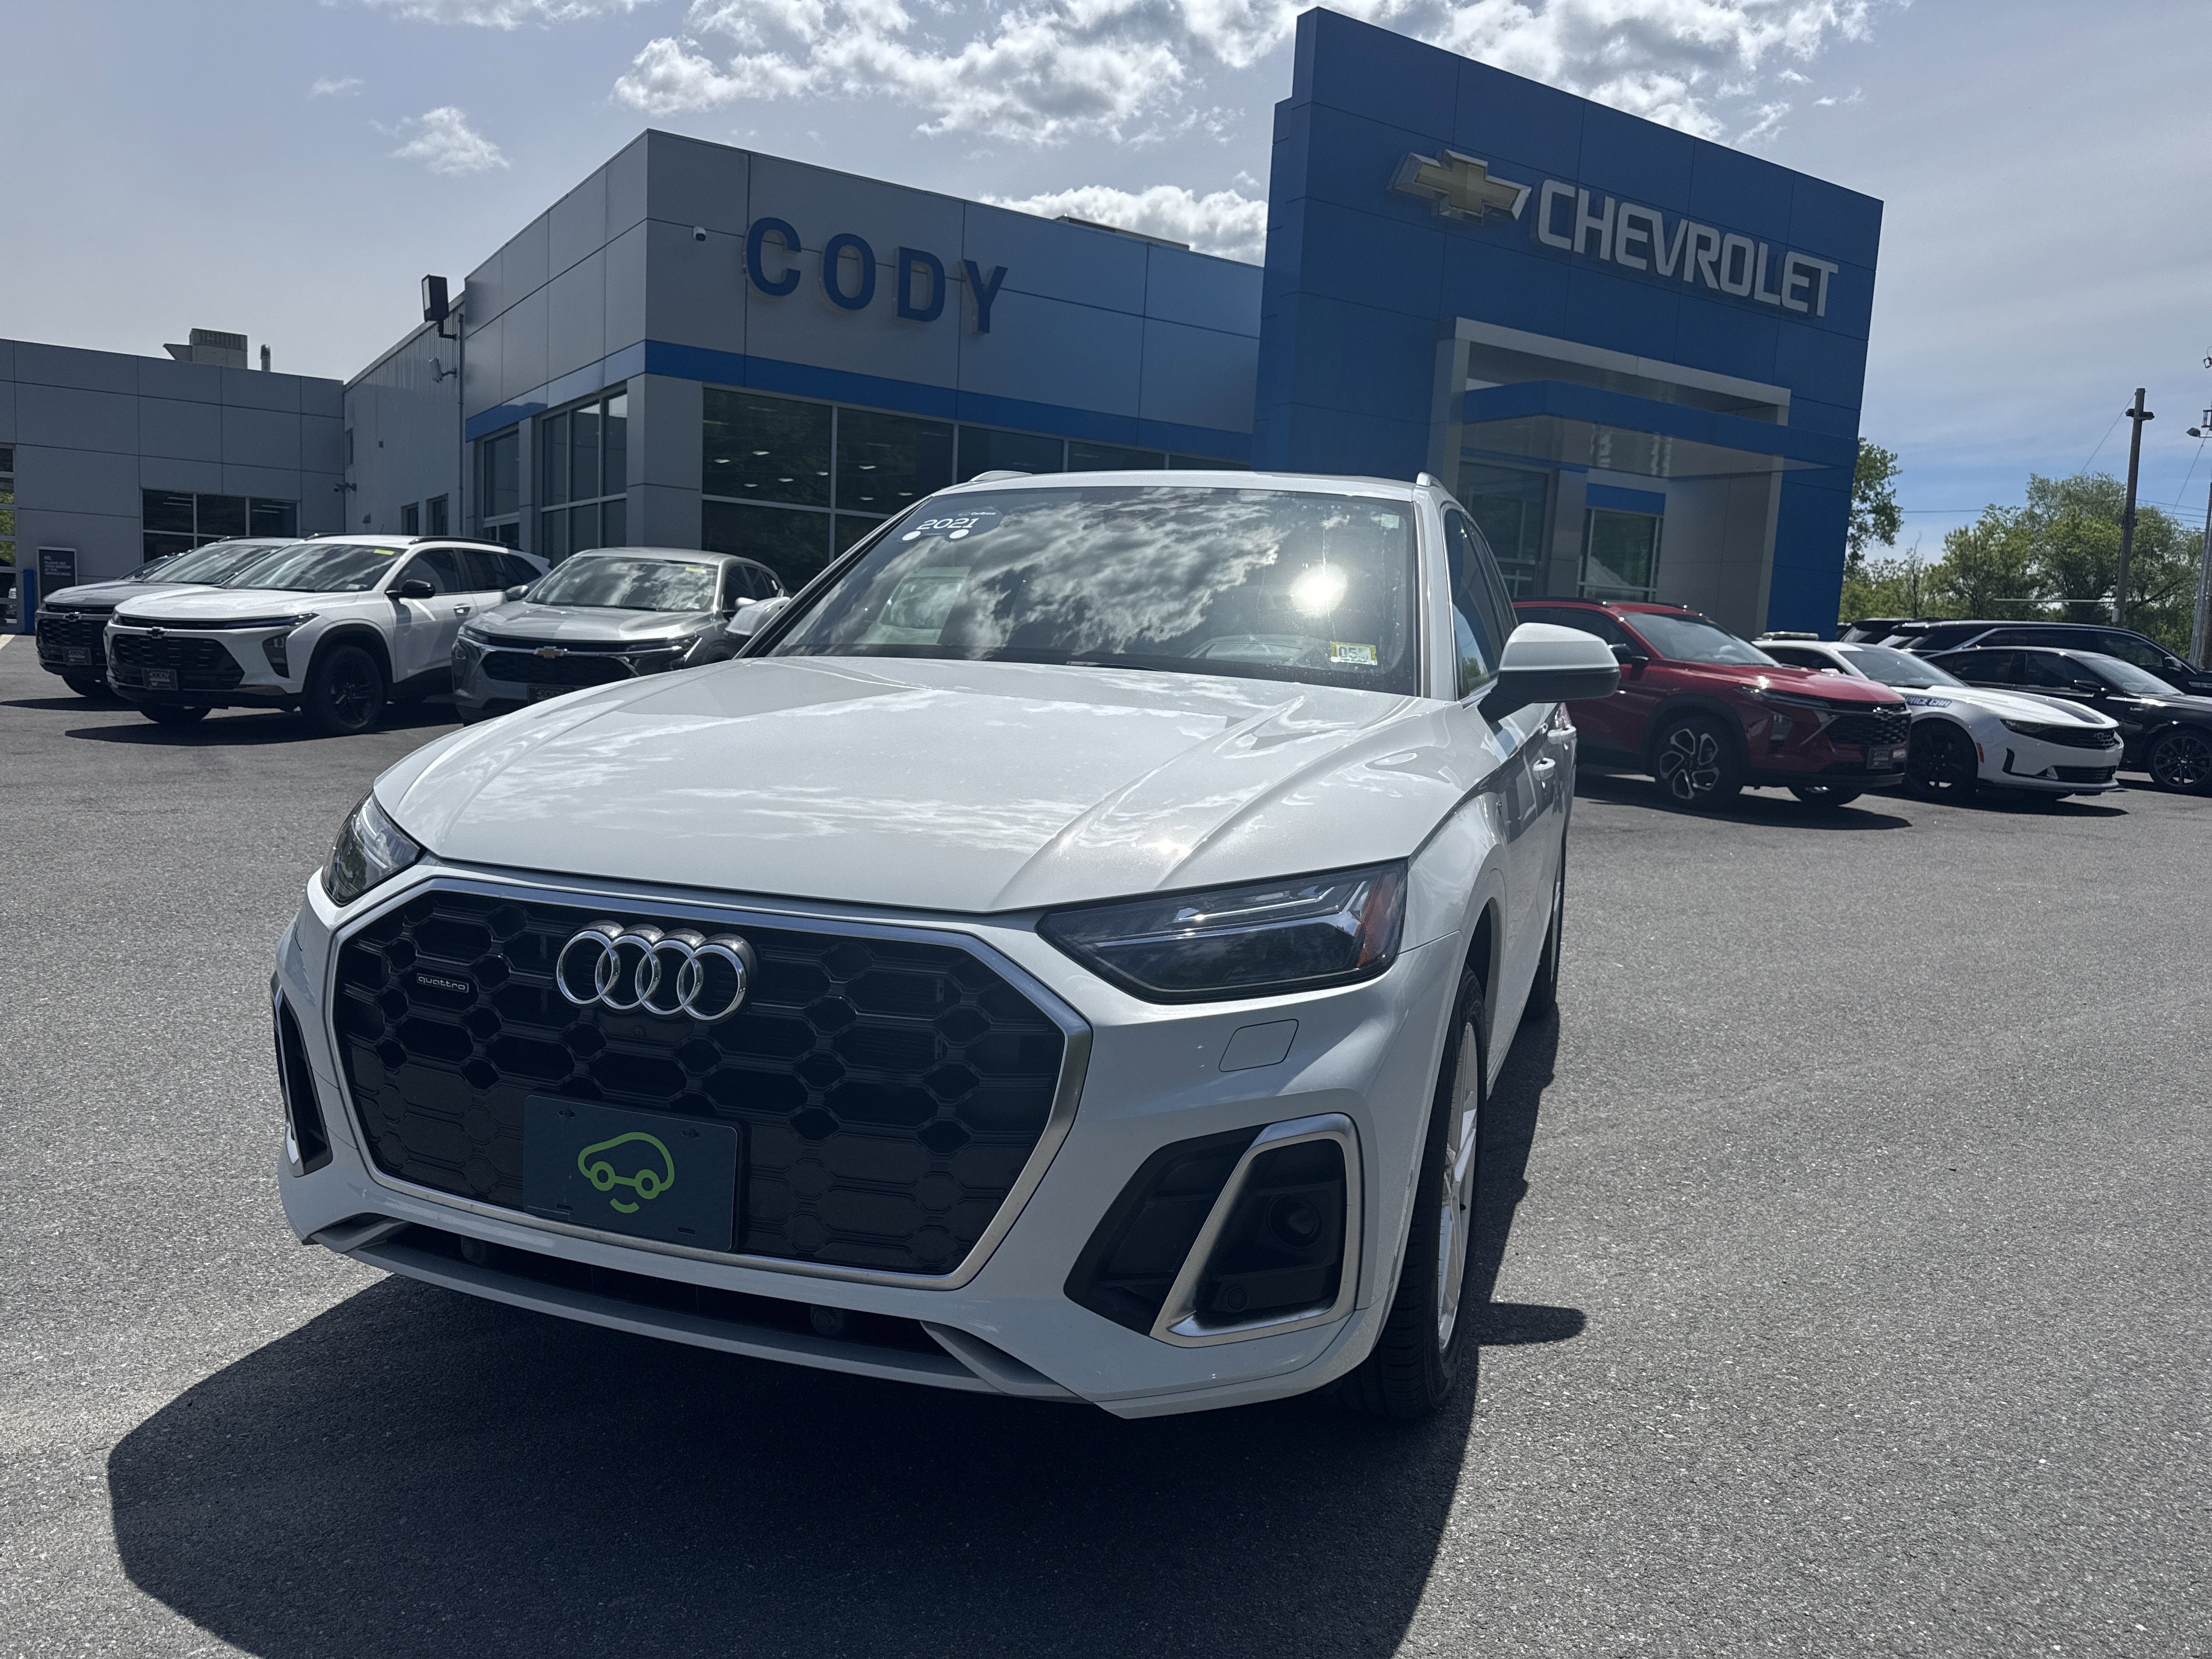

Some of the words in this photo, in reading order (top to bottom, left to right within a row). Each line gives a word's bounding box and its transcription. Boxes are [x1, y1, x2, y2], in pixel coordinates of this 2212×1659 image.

[1537, 178, 1839, 318] CHEVROLET
[743, 217, 1009, 334] CODY
[916, 517, 980, 531] 2021
[1905, 696, 1929, 705] PACE
[1928, 698, 1951, 707] CAR
[418, 976, 466, 990] quattro
